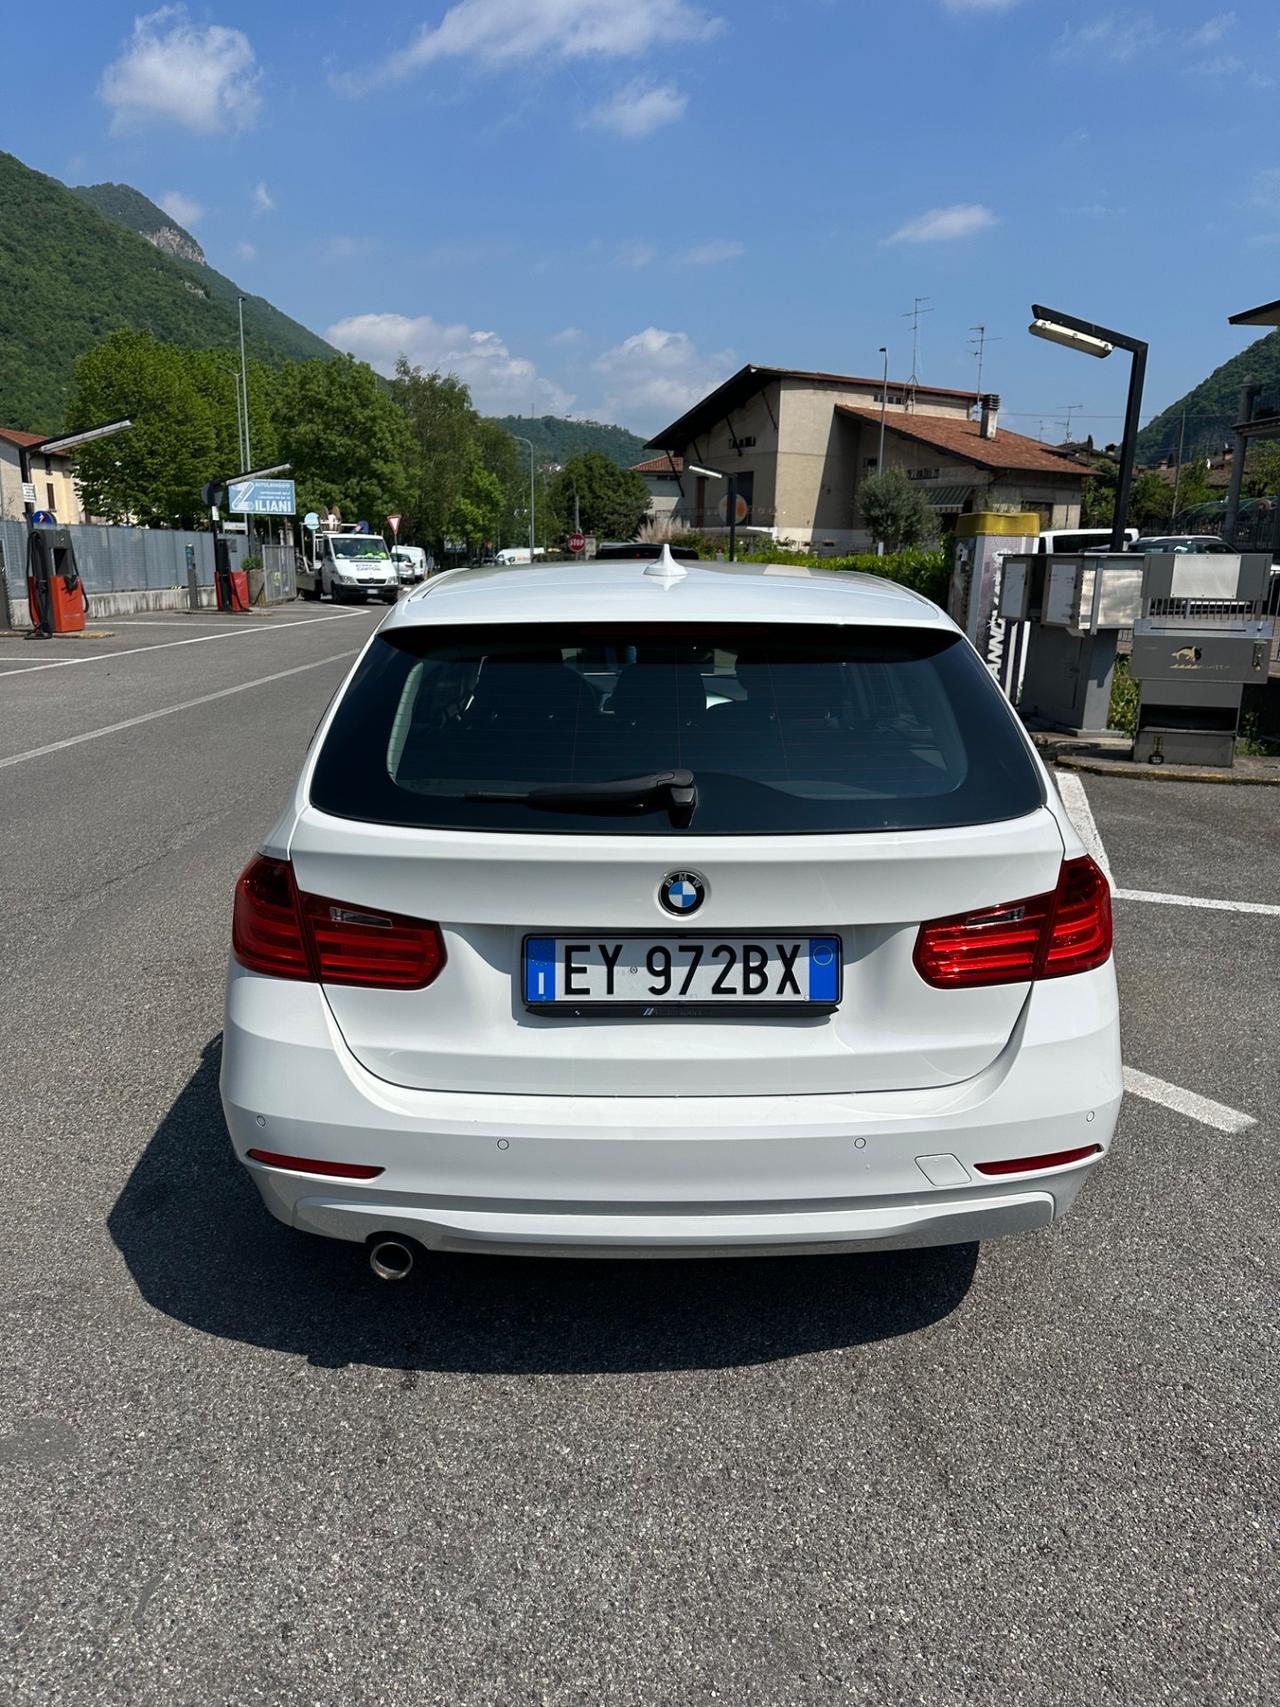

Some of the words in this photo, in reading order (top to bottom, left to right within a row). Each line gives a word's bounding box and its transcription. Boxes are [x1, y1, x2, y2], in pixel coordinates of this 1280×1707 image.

[569, 537, 585, 547] STOP
[664, 872, 703, 889] BMW
[564, 944, 624, 996] EY
[646, 944, 802, 996] 972BX
